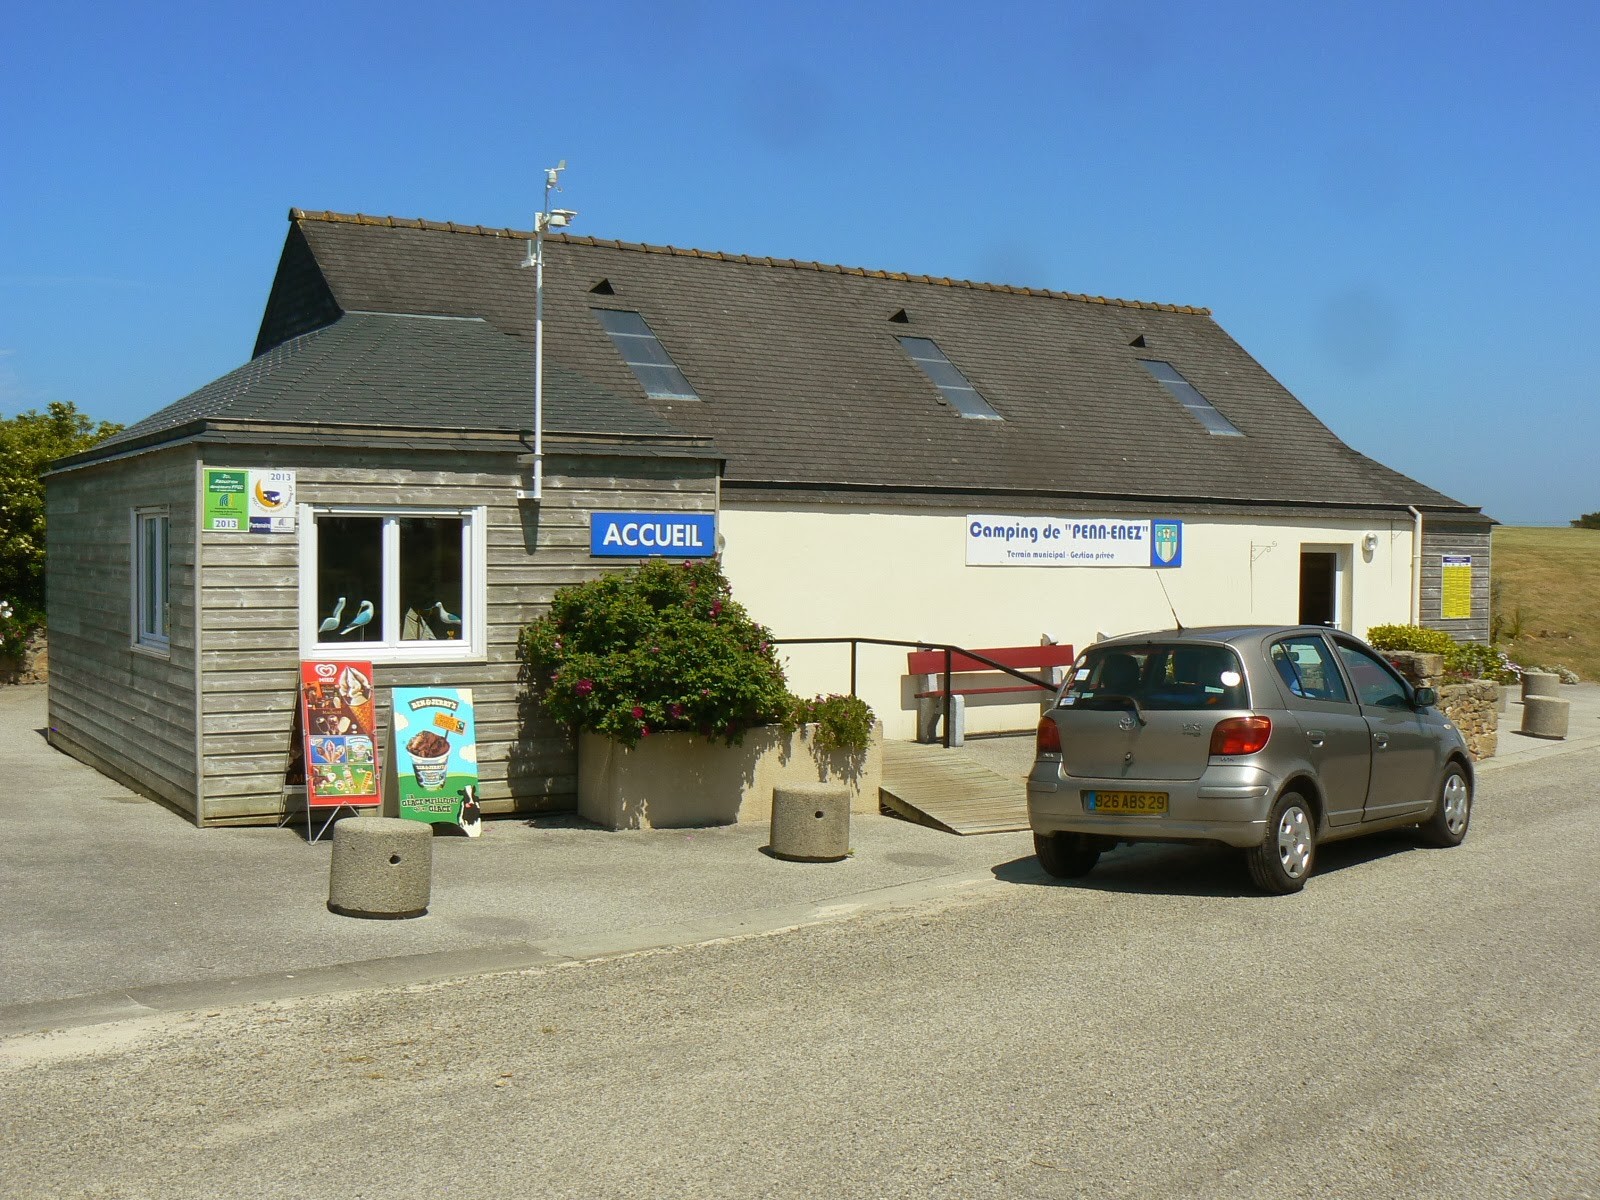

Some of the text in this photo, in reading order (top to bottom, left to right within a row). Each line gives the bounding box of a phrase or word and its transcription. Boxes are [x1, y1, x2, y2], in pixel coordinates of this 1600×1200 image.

[270, 473, 291, 481] 2013
[215, 520, 237, 528] 2013
[602, 523, 703, 547] ACCUEIL
[970, 521, 1038, 543] Camping
[1043, 524, 1061, 539] de
[1007, 550, 1031, 558] Terrain
[1033, 550, 1065, 560] municipal
[1070, 551, 1094, 559] Gestion
[1095, 551, 1115, 560] privée
[402, 797, 458, 807] GLACE MEILLEURE
[1095, 794, 1165, 810] 926 ABS 29
[428, 805, 452, 813] GLACE
